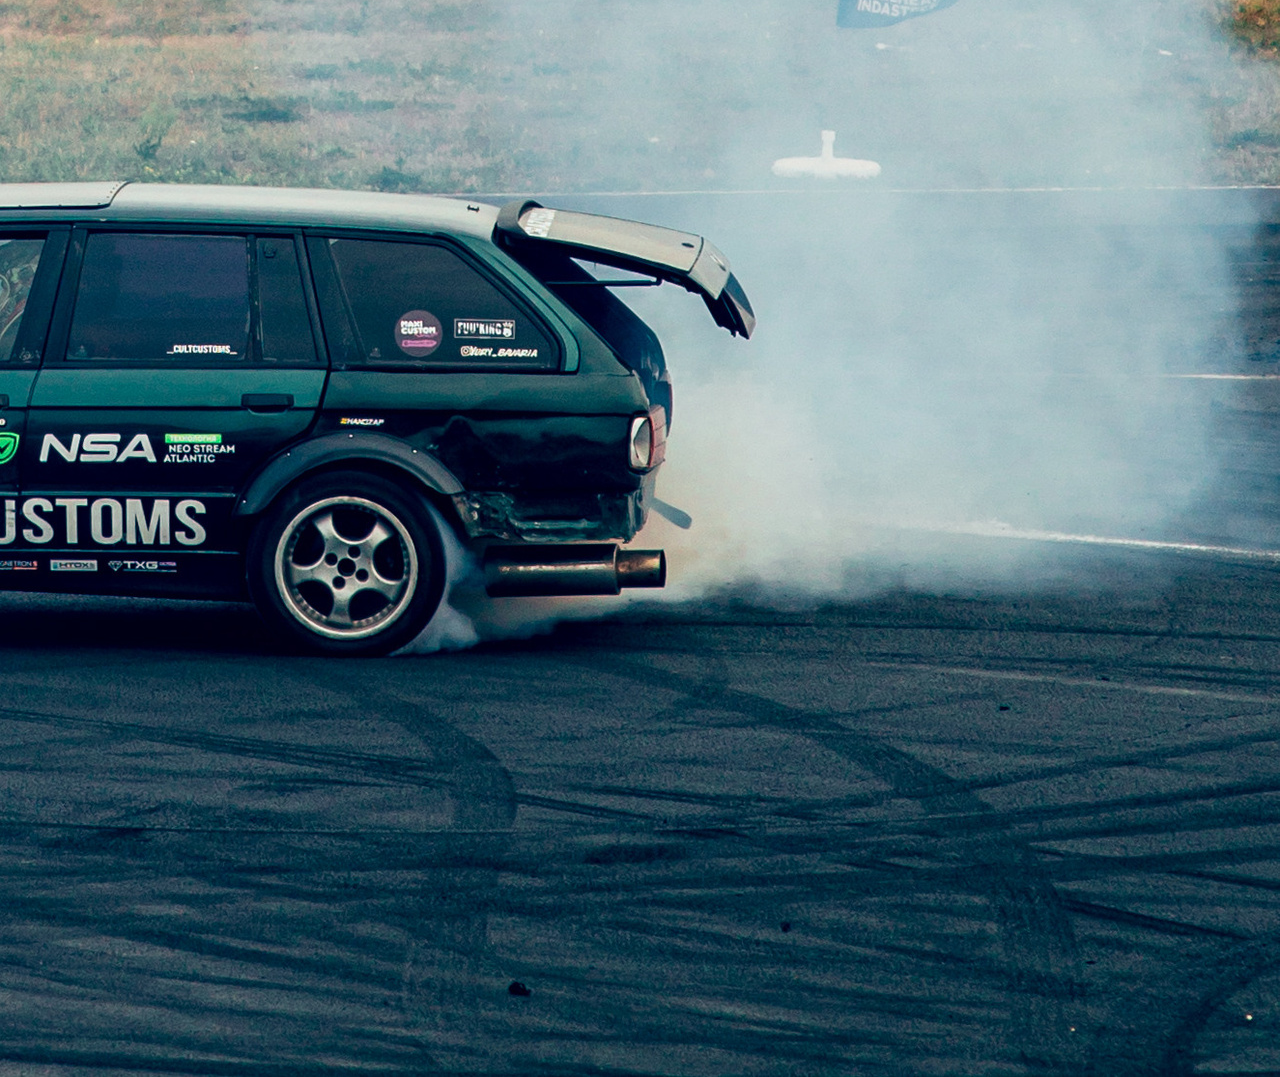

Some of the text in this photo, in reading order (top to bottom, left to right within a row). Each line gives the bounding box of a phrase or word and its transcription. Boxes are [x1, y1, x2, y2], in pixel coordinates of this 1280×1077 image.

[400, 320, 423, 328] MAXI
[401, 327, 436, 335] CUSTOM
[39, 433, 157, 463] NSA
[168, 444, 235, 453] NEO STREAM
[163, 454, 216, 463] ATLANTIC
